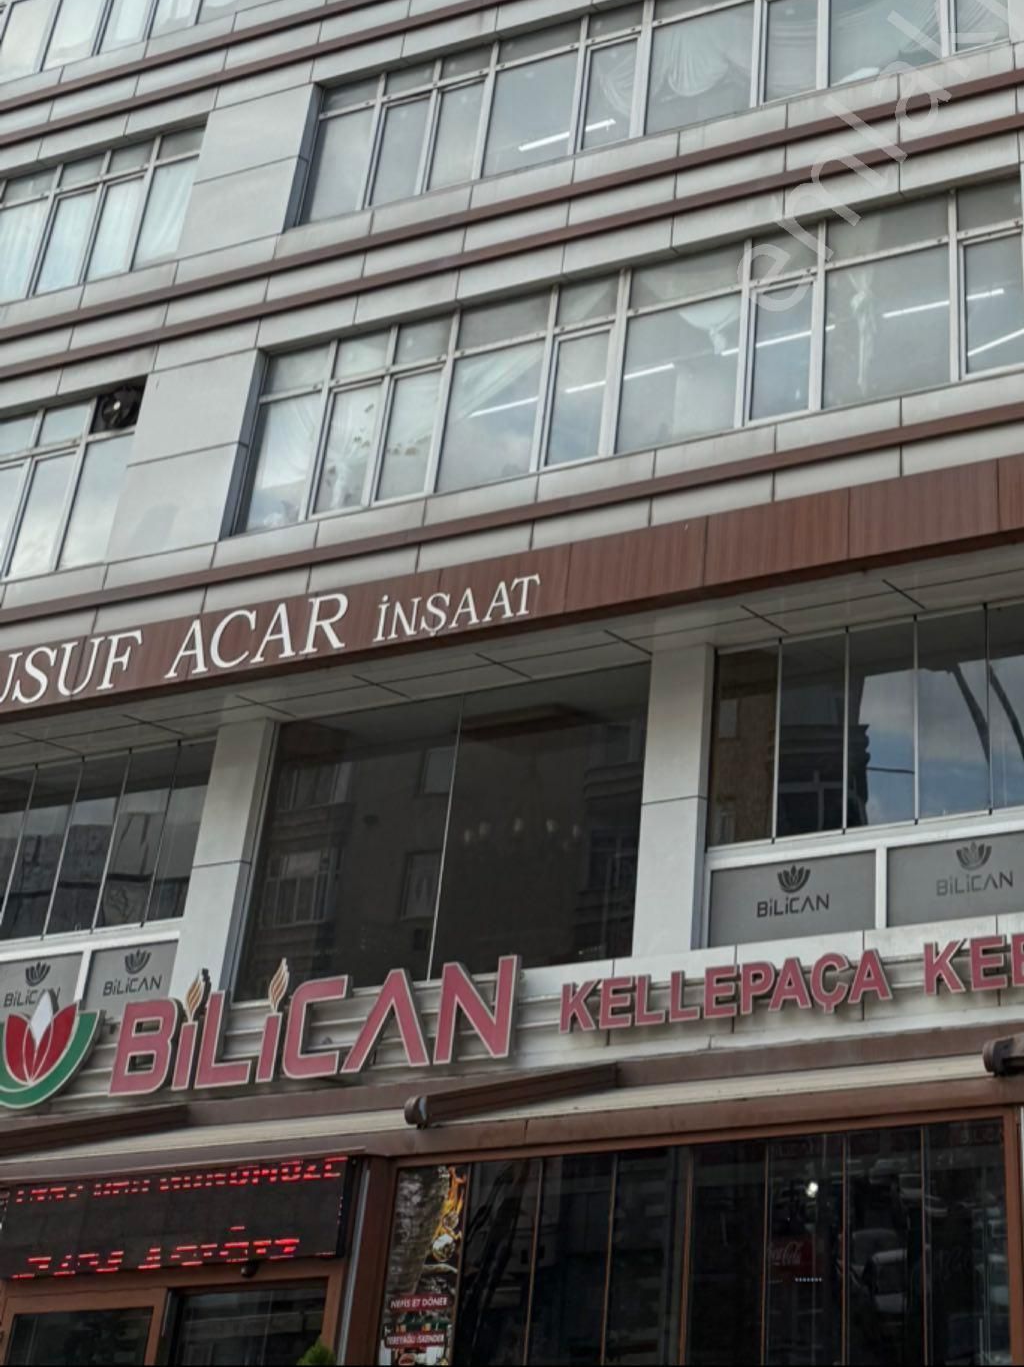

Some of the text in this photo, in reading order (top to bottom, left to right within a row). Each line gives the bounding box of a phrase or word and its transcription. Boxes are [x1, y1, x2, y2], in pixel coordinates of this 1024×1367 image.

[164, 593, 348, 678] ACAR
[372, 573, 541, 637] İNŞAAT
[559, 948, 893, 1034] KELLEPAÇA
